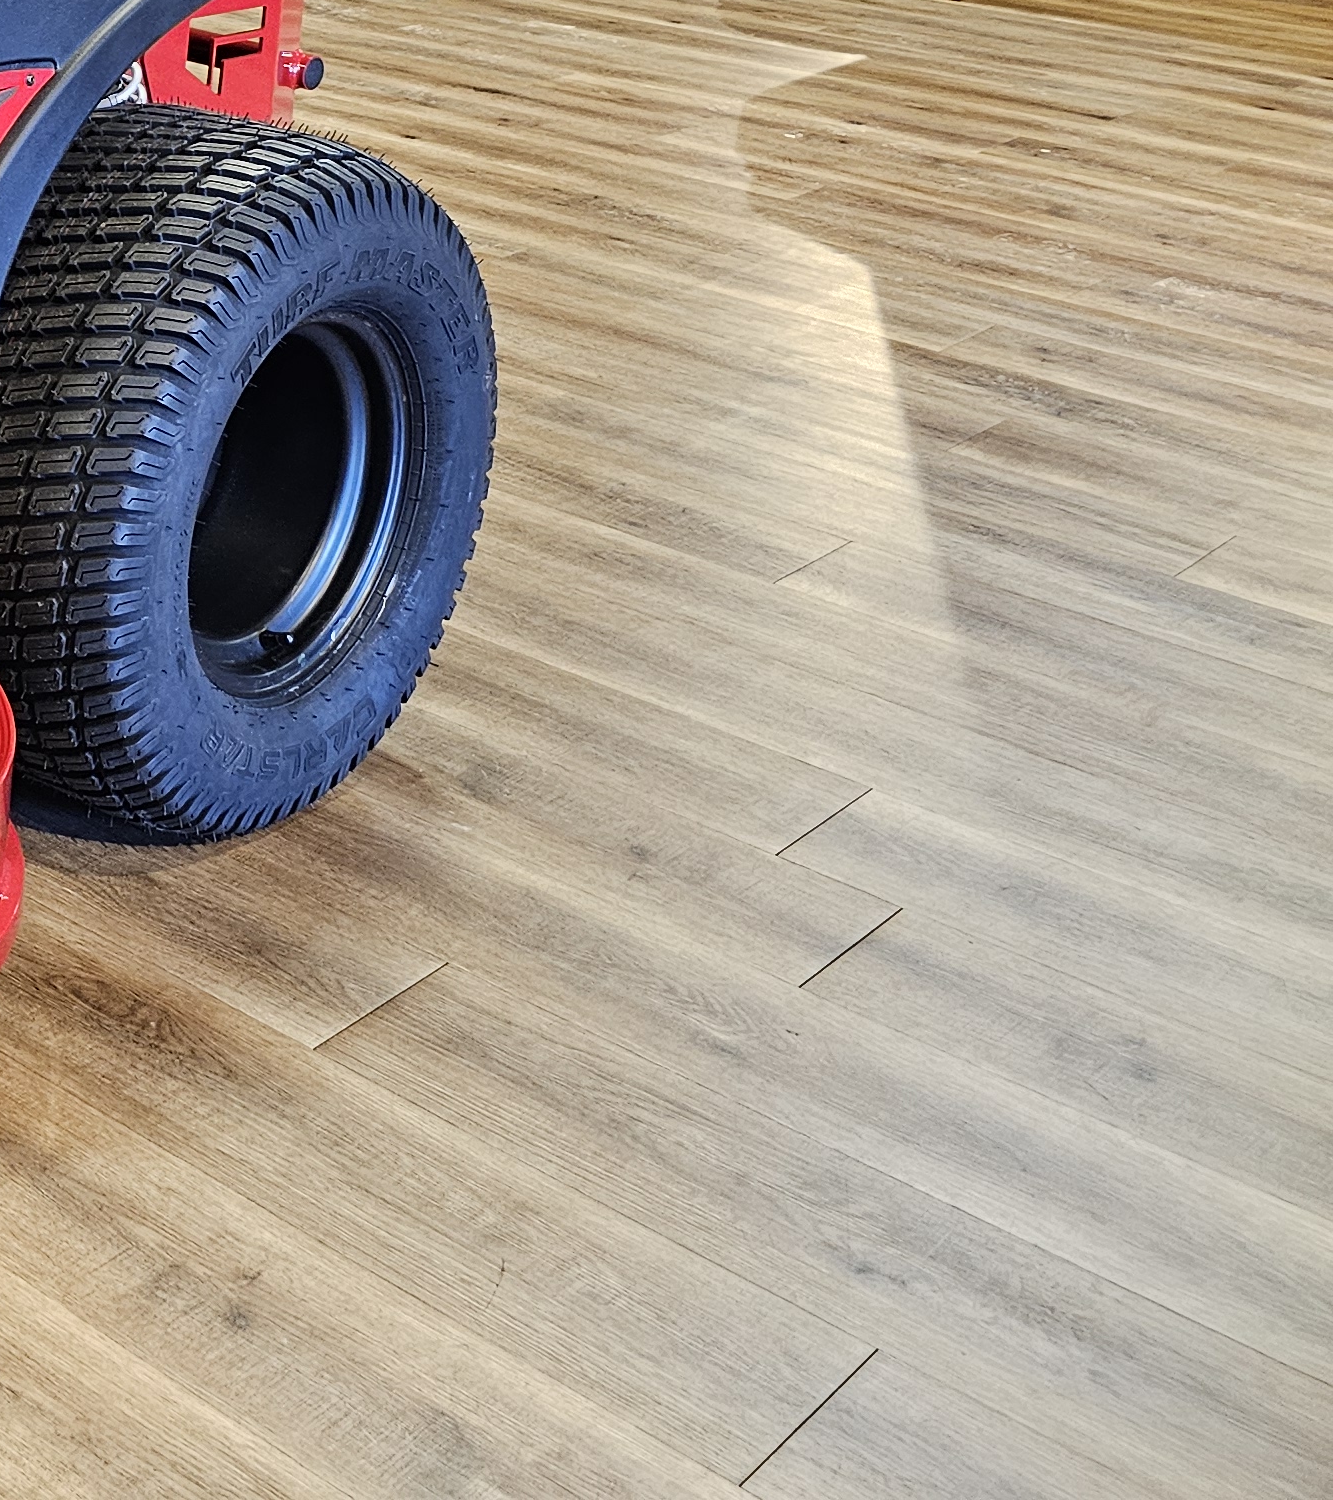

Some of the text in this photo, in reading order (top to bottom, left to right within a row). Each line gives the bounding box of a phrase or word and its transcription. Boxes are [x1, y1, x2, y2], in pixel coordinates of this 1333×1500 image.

[231, 248, 479, 388] TURF MASTER
[200, 696, 377, 781] CARLSTAR
